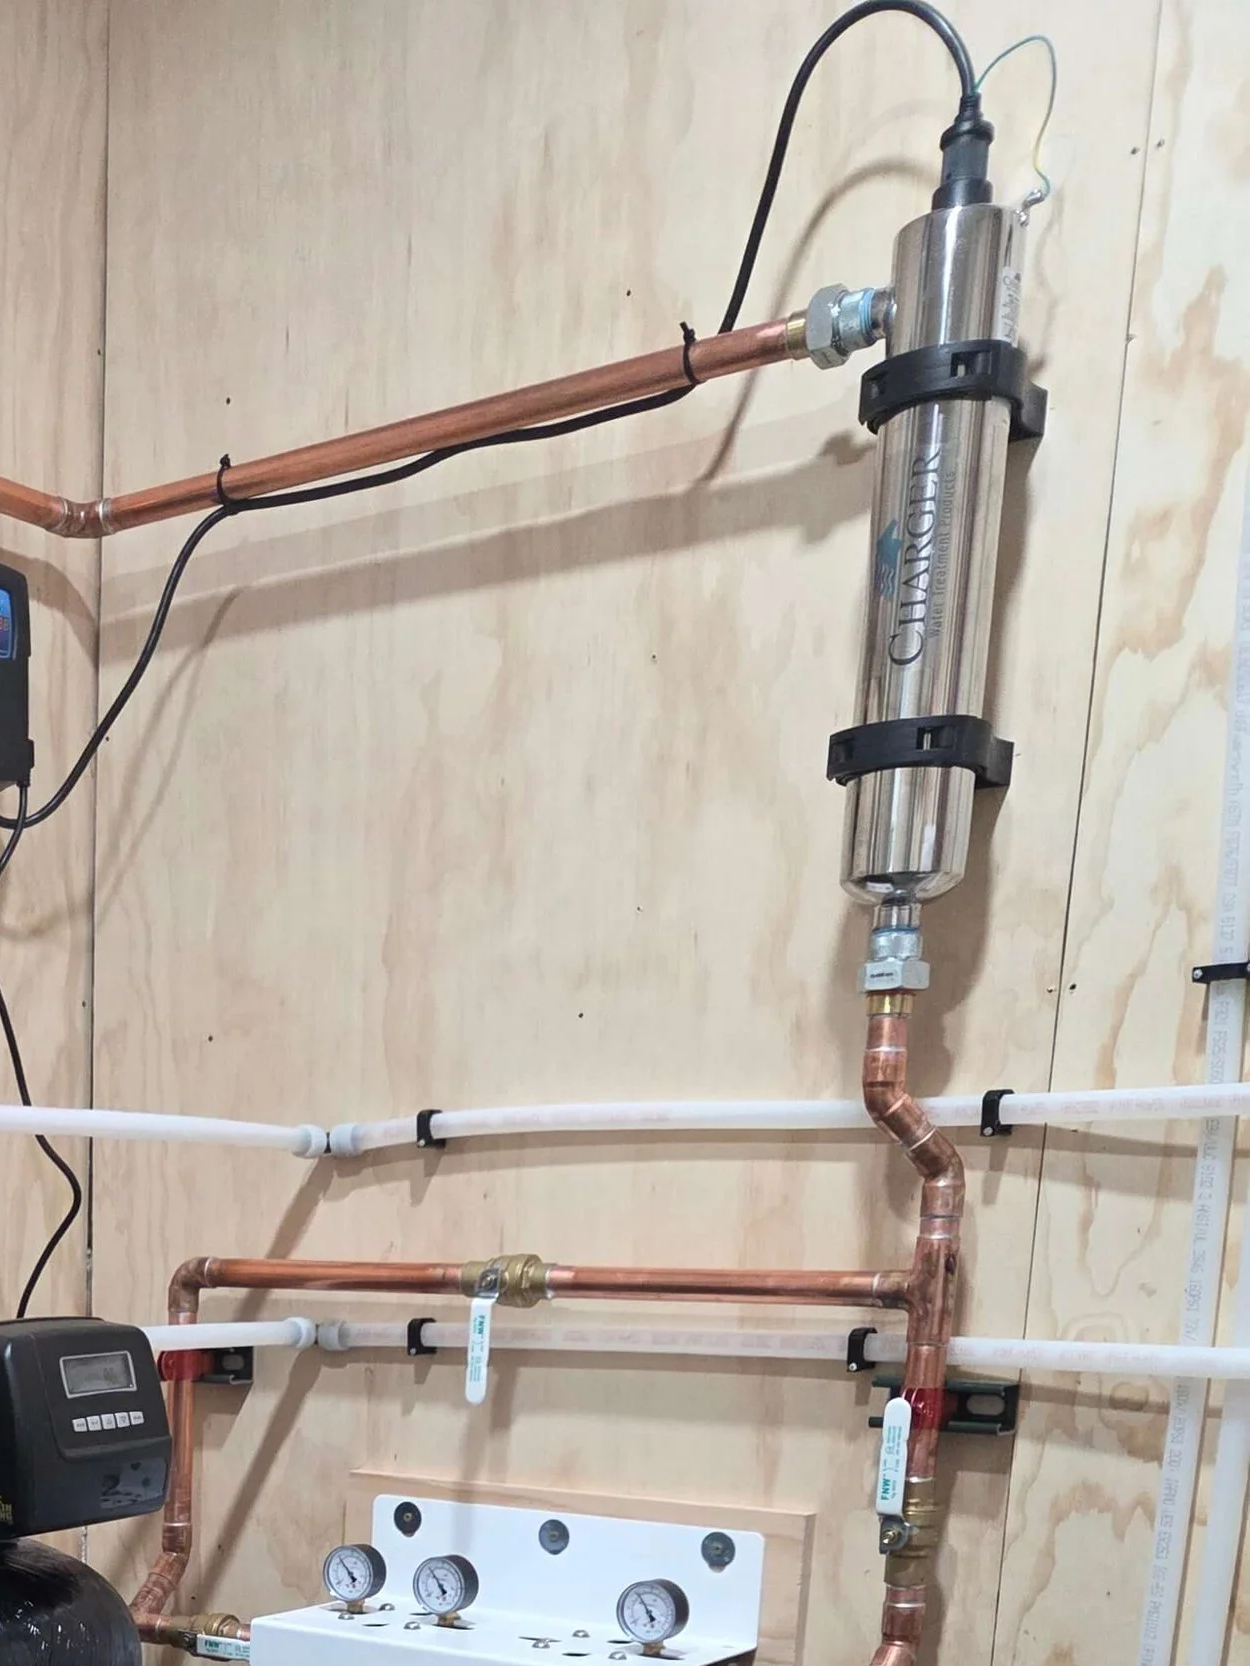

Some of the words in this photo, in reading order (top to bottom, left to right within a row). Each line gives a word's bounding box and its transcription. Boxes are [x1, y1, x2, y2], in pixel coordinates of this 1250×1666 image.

[940, 471, 956, 527] Products
[888, 448, 940, 666] CHARGER
[932, 532, 950, 595] Treatment
[928, 602, 944, 639] Water
[880, 1478, 890, 1501] FNW
